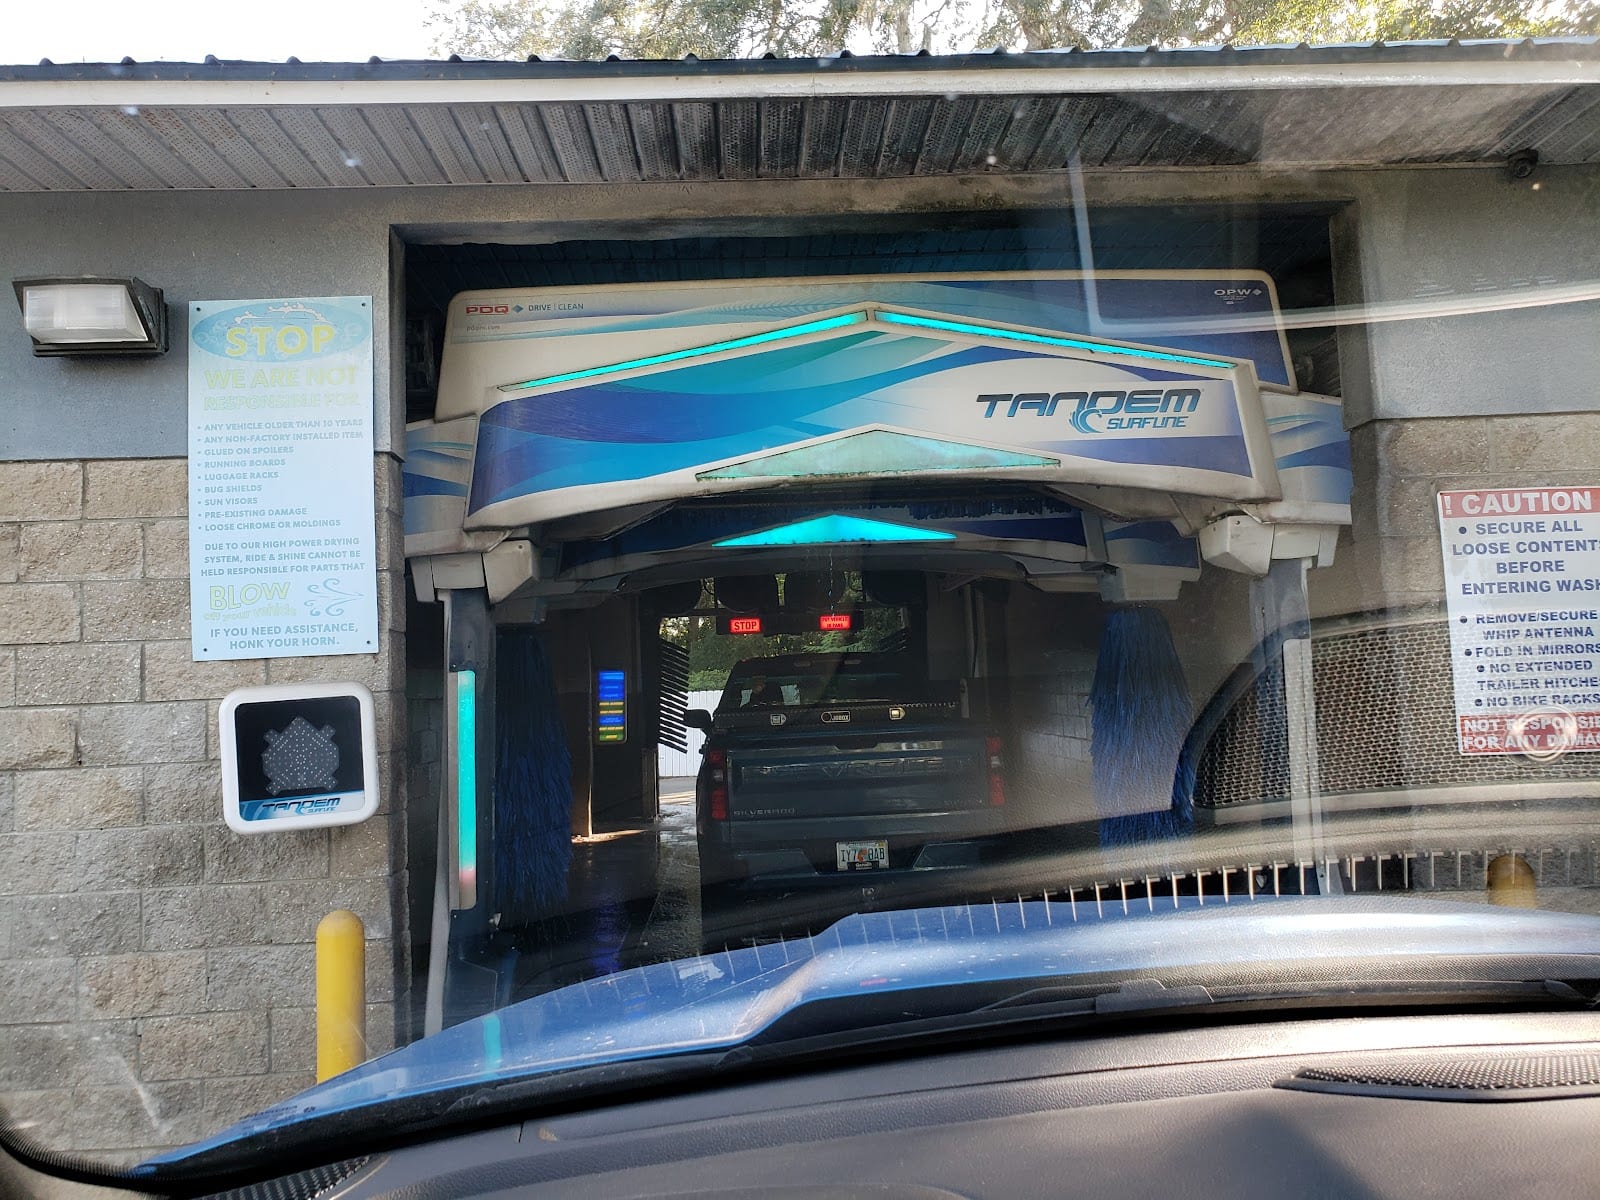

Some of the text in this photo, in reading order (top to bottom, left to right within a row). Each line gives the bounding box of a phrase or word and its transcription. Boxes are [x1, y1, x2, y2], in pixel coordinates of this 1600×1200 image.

[1214, 288, 1252, 296] OPW
[465, 303, 584, 314] PDQ DRIVE CLEAN
[225, 324, 335, 356] STOP
[204, 366, 358, 390] WE ARE NOT
[204, 393, 320, 411] RESPONSIBLE
[976, 388, 1201, 418] TANDEM
[225, 422, 262, 431] VEHICLE
[323, 420, 333, 428] 10
[335, 419, 363, 427] YEARS
[1106, 416, 1189, 430] SURFLINE
[226, 434, 290, 443] NON-FACTORY
[293, 432, 340, 441] INSTALLED
[253, 447, 294, 455] SPOILERS
[204, 459, 286, 468] RUNNING BOARDS
[204, 473, 247, 481] LUGGAGE
[1461, 491, 1592, 514] CAUTION
[204, 508, 307, 518] PRE-EXISTING DAMAGE
[237, 522, 275, 530] CHROME
[278, 521, 291, 529] OR
[293, 520, 341, 528] MOLDINGS
[1476, 520, 1583, 535] SECURE ALL
[205, 543, 223, 551] DUE
[226, 542, 238, 550] TO
[262, 540, 286, 548] HIGH
[289, 539, 322, 547] POWER
[324, 538, 359, 546] DRYING
[1452, 539, 1600, 556] LOOSE CONTENT
[204, 556, 243, 564] SYSTEM,
[246, 554, 266, 562] RIDE
[278, 552, 306, 560] SHINE
[308, 551, 347, 560] CANNOT
[350, 550, 361, 558] BE
[201, 568, 224, 576] HELD
[227, 565, 288, 575] RESPONSIBLE
[1496, 560, 1565, 574] BEFORE
[1461, 581, 1551, 595] ENTERING
[209, 582, 290, 610] BLOW
[1476, 610, 1598, 624] REMOVE/SECURE
[211, 623, 358, 638] IF YOU NEED ASSISTANCE,
[734, 620, 757, 631] STOP
[1483, 627, 1594, 640] WHIP ANTENNA
[230, 637, 340, 649] HONK YOUR HORN.
[1476, 647, 1513, 657] FOLD
[1518, 646, 1532, 655] IN
[1490, 660, 1592, 673] NO EXTENDED
[1477, 677, 1600, 690] TRAILER HITCHE
[1487, 694, 1600, 707] NO BIKE RACKS
[1464, 720, 1500, 731] NOT
[1463, 736, 1500, 750] FOR
[1505, 734, 1541, 747] ANY
[262, 797, 341, 812] TANDEM
